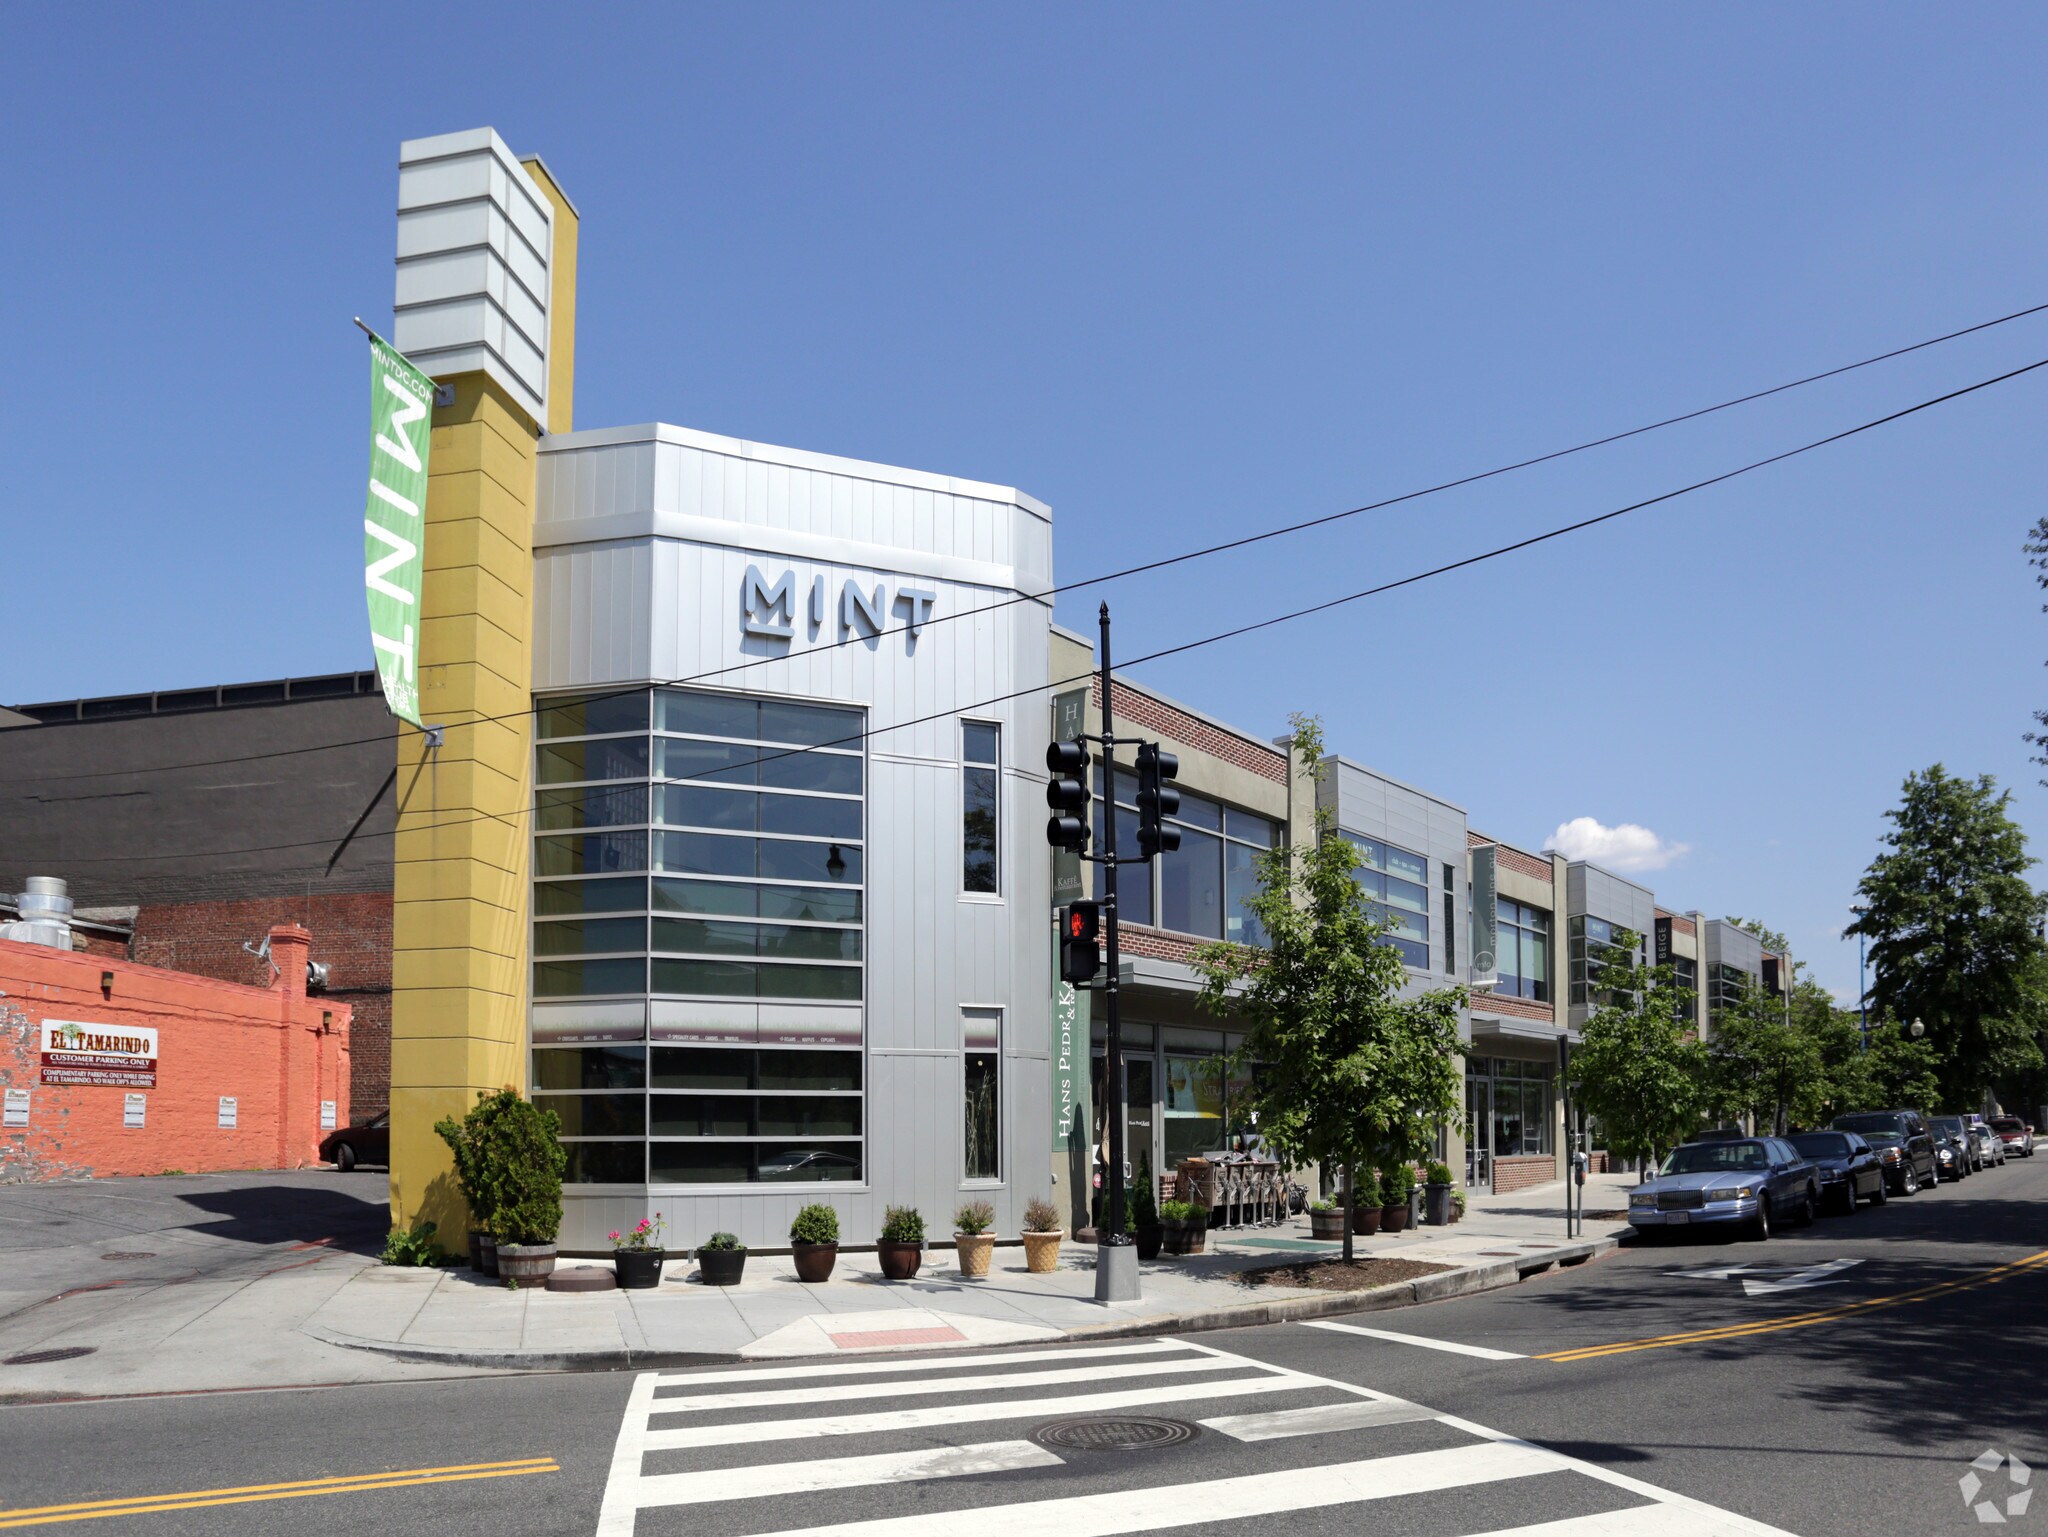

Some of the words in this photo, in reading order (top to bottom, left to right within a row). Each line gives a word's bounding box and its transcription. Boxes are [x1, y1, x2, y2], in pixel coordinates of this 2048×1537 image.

[364, 374, 427, 682] MINT
[745, 563, 938, 638] MINT
[1658, 927, 1667, 959] BEIGE
[1066, 1008, 1075, 1020] &
[50, 1030, 66, 1049] EL
[76, 1032, 150, 1054] TAMARINDO
[43, 1069, 86, 1077] COMPLIMENTARY
[50, 1054, 94, 1063] CUSTOMER
[95, 1056, 129, 1065] PARKING
[130, 1058, 150, 1066] ONLY
[1059, 1079, 1071, 1138] HANS
